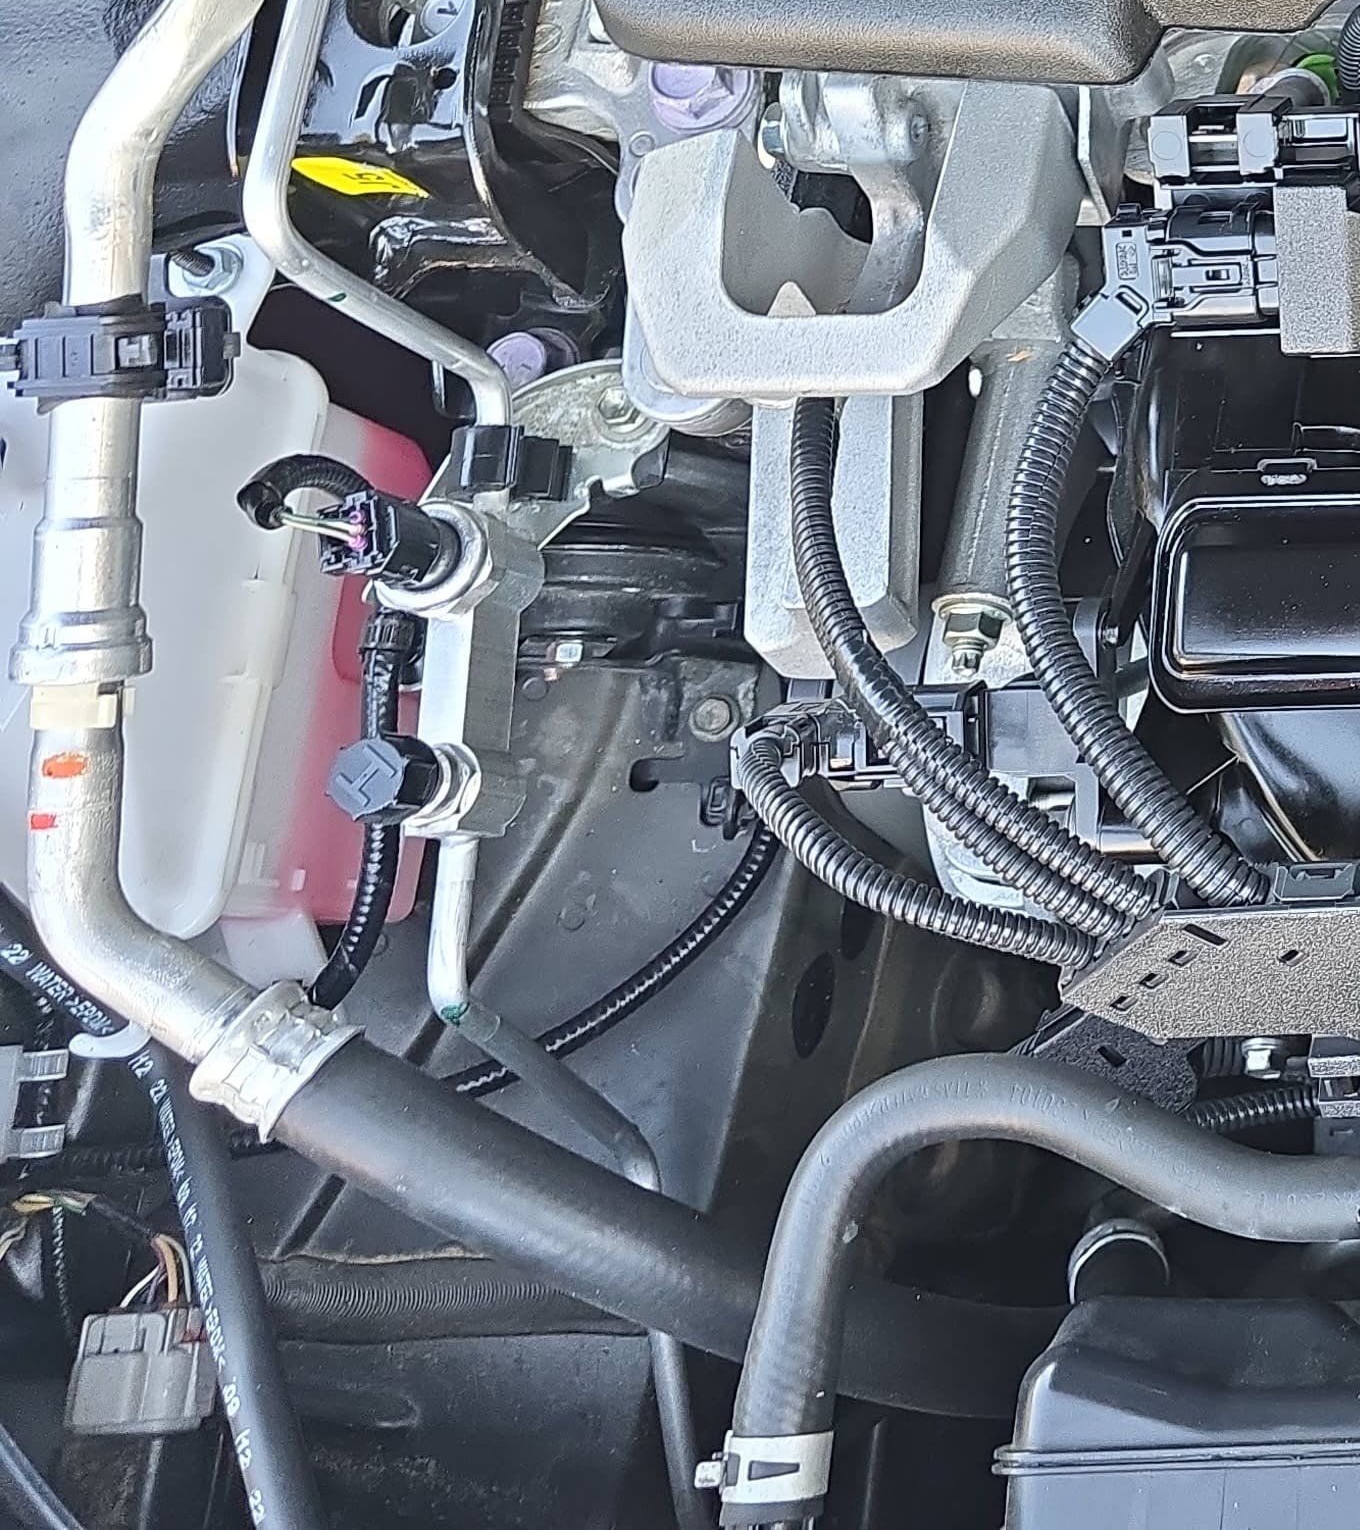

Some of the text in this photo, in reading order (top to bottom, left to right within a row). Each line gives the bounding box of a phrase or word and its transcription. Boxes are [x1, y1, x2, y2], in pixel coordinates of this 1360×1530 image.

[25, 958, 76, 1005] WATER
[158, 1097, 177, 1142] WATER
[194, 1256, 214, 1303] WATER
